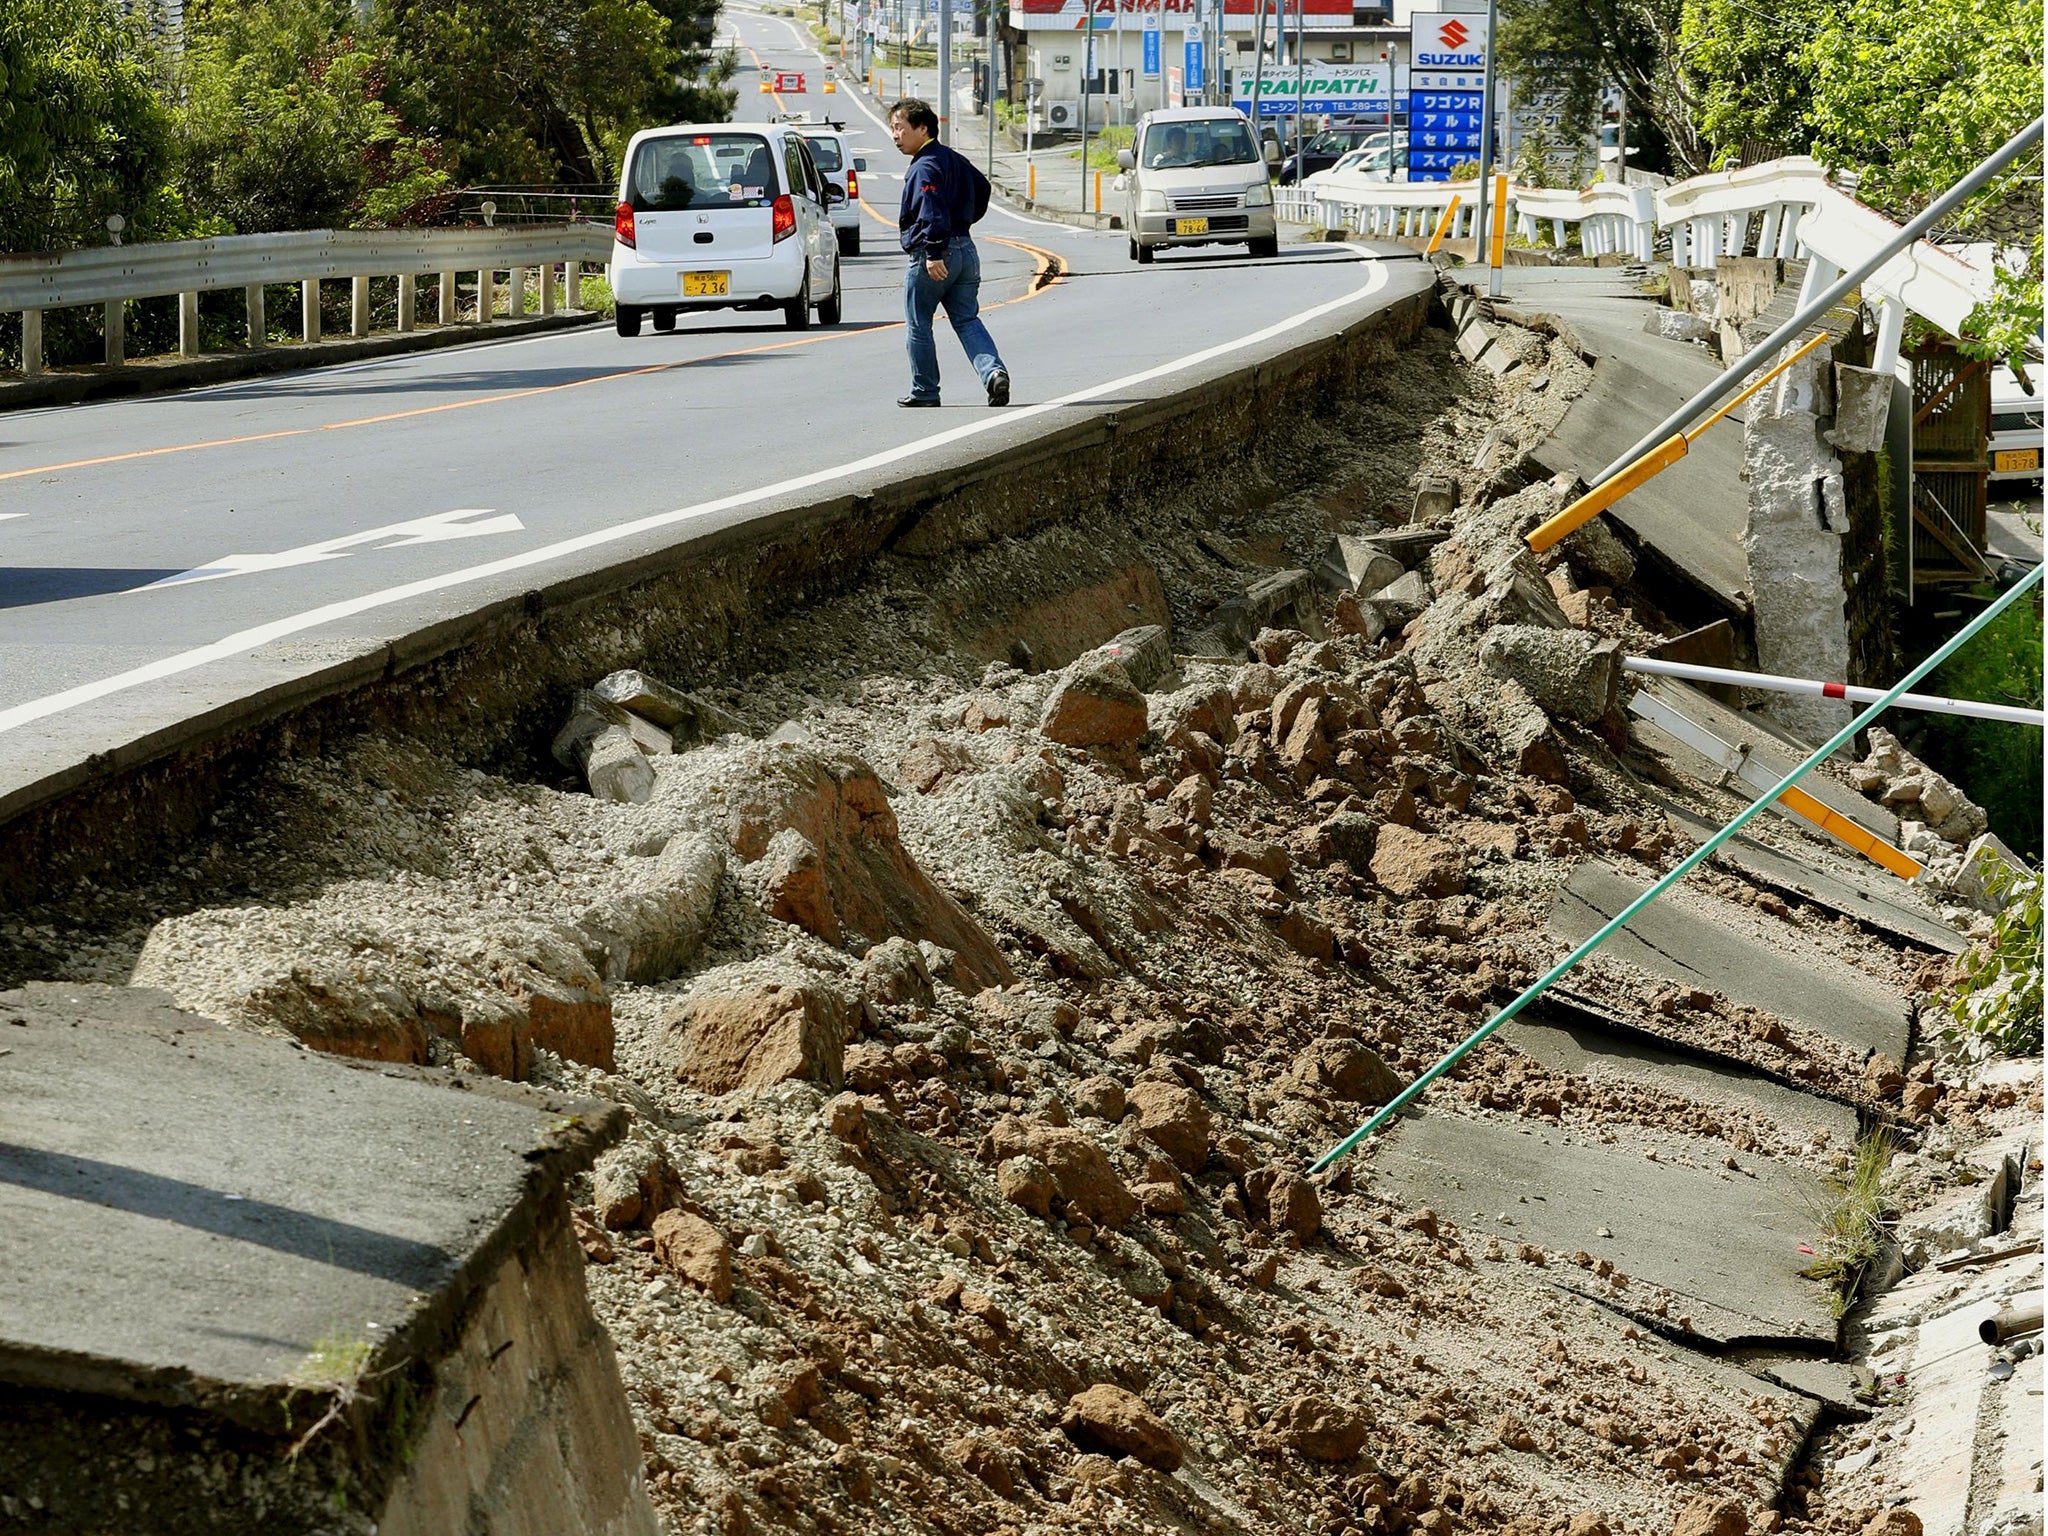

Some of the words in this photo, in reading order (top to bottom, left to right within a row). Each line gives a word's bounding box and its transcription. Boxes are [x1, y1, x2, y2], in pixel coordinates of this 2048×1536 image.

[1418, 53, 1483, 65] SUZUK
[1241, 79, 1379, 95] TRANPATH
[1332, 101, 1402, 110] TEL.289-638
[1423, 95, 1481, 109] ワゴンR
[1423, 115, 1481, 129] アルト
[1423, 133, 1480, 147] セルボ
